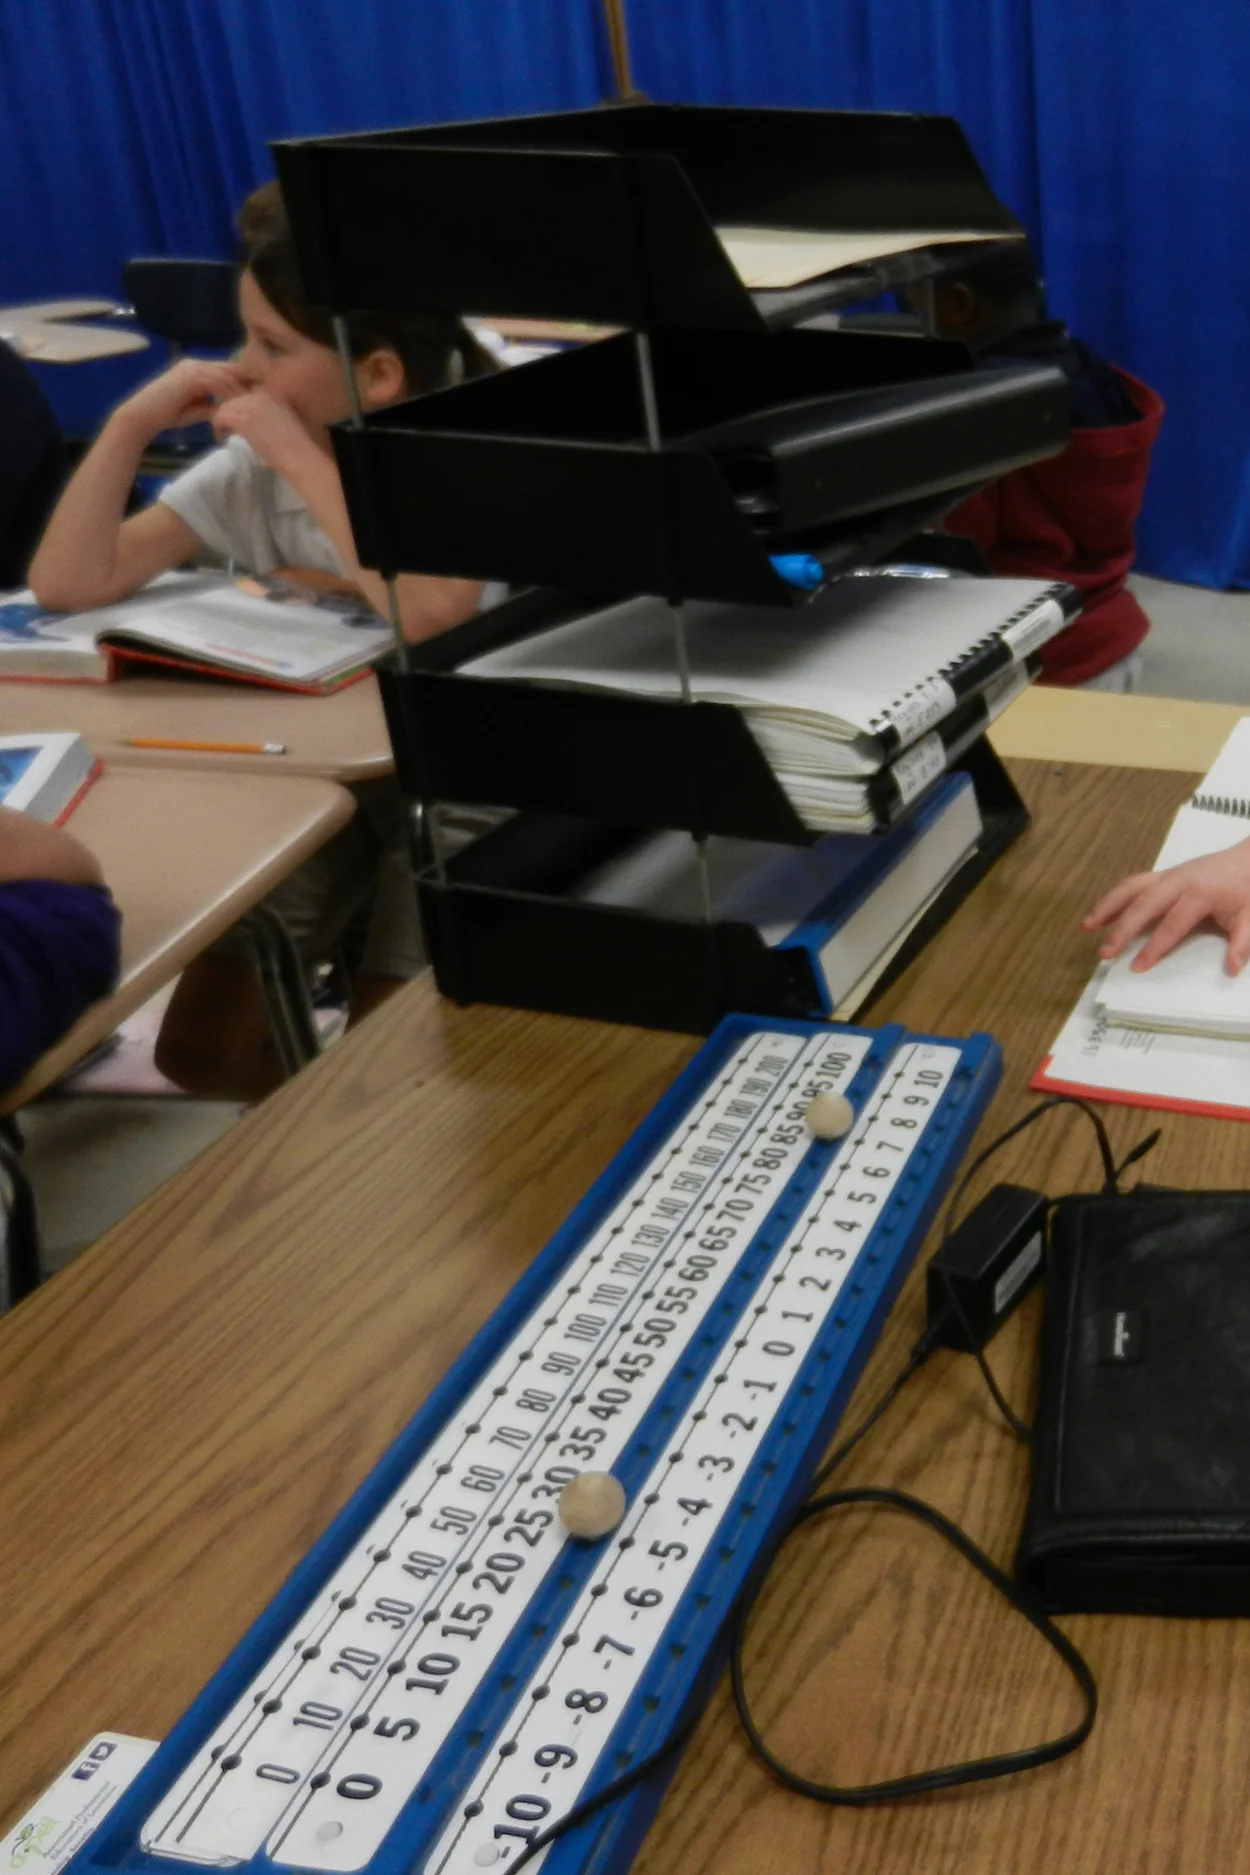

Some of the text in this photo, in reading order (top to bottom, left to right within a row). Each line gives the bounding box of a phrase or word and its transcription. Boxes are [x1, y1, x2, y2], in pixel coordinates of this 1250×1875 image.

[815, 1052, 852, 1080] 100
[769, 1124, 805, 1146] 85
[751, 1147, 789, 1171] 80
[733, 1173, 772, 1195] 75
[715, 1199, 754, 1222] 70
[698, 1225, 737, 1252] 65
[677, 1254, 718, 1282] 60
[654, 1285, 698, 1315] 55
[632, 1317, 677, 1349] 50
[612, 1352, 655, 1384] 45
[255, 1054, 789, 1785] 0 10 20 30 40 50 60 70 80 90 100 110 120 130 140 150 160 170 180 190 200
[587, 1387, 633, 1422] 40
[558, 1426, 607, 1462] 35
[493, 1069, 944, 1860] -10 -9 -8 -7 -6 -5 -4 -3 -2 -1 0 1 2 3 4 5 6 7 8 9 10
[531, 1466, 580, 1503] 30
[503, 1508, 555, 1548] 25
[471, 1551, 526, 1595] 20
[440, 1602, 494, 1642] 15
[405, 1652, 461, 1696] 10
[372, 1716, 421, 1742] 5
[335, 1773, 383, 1801] 0
